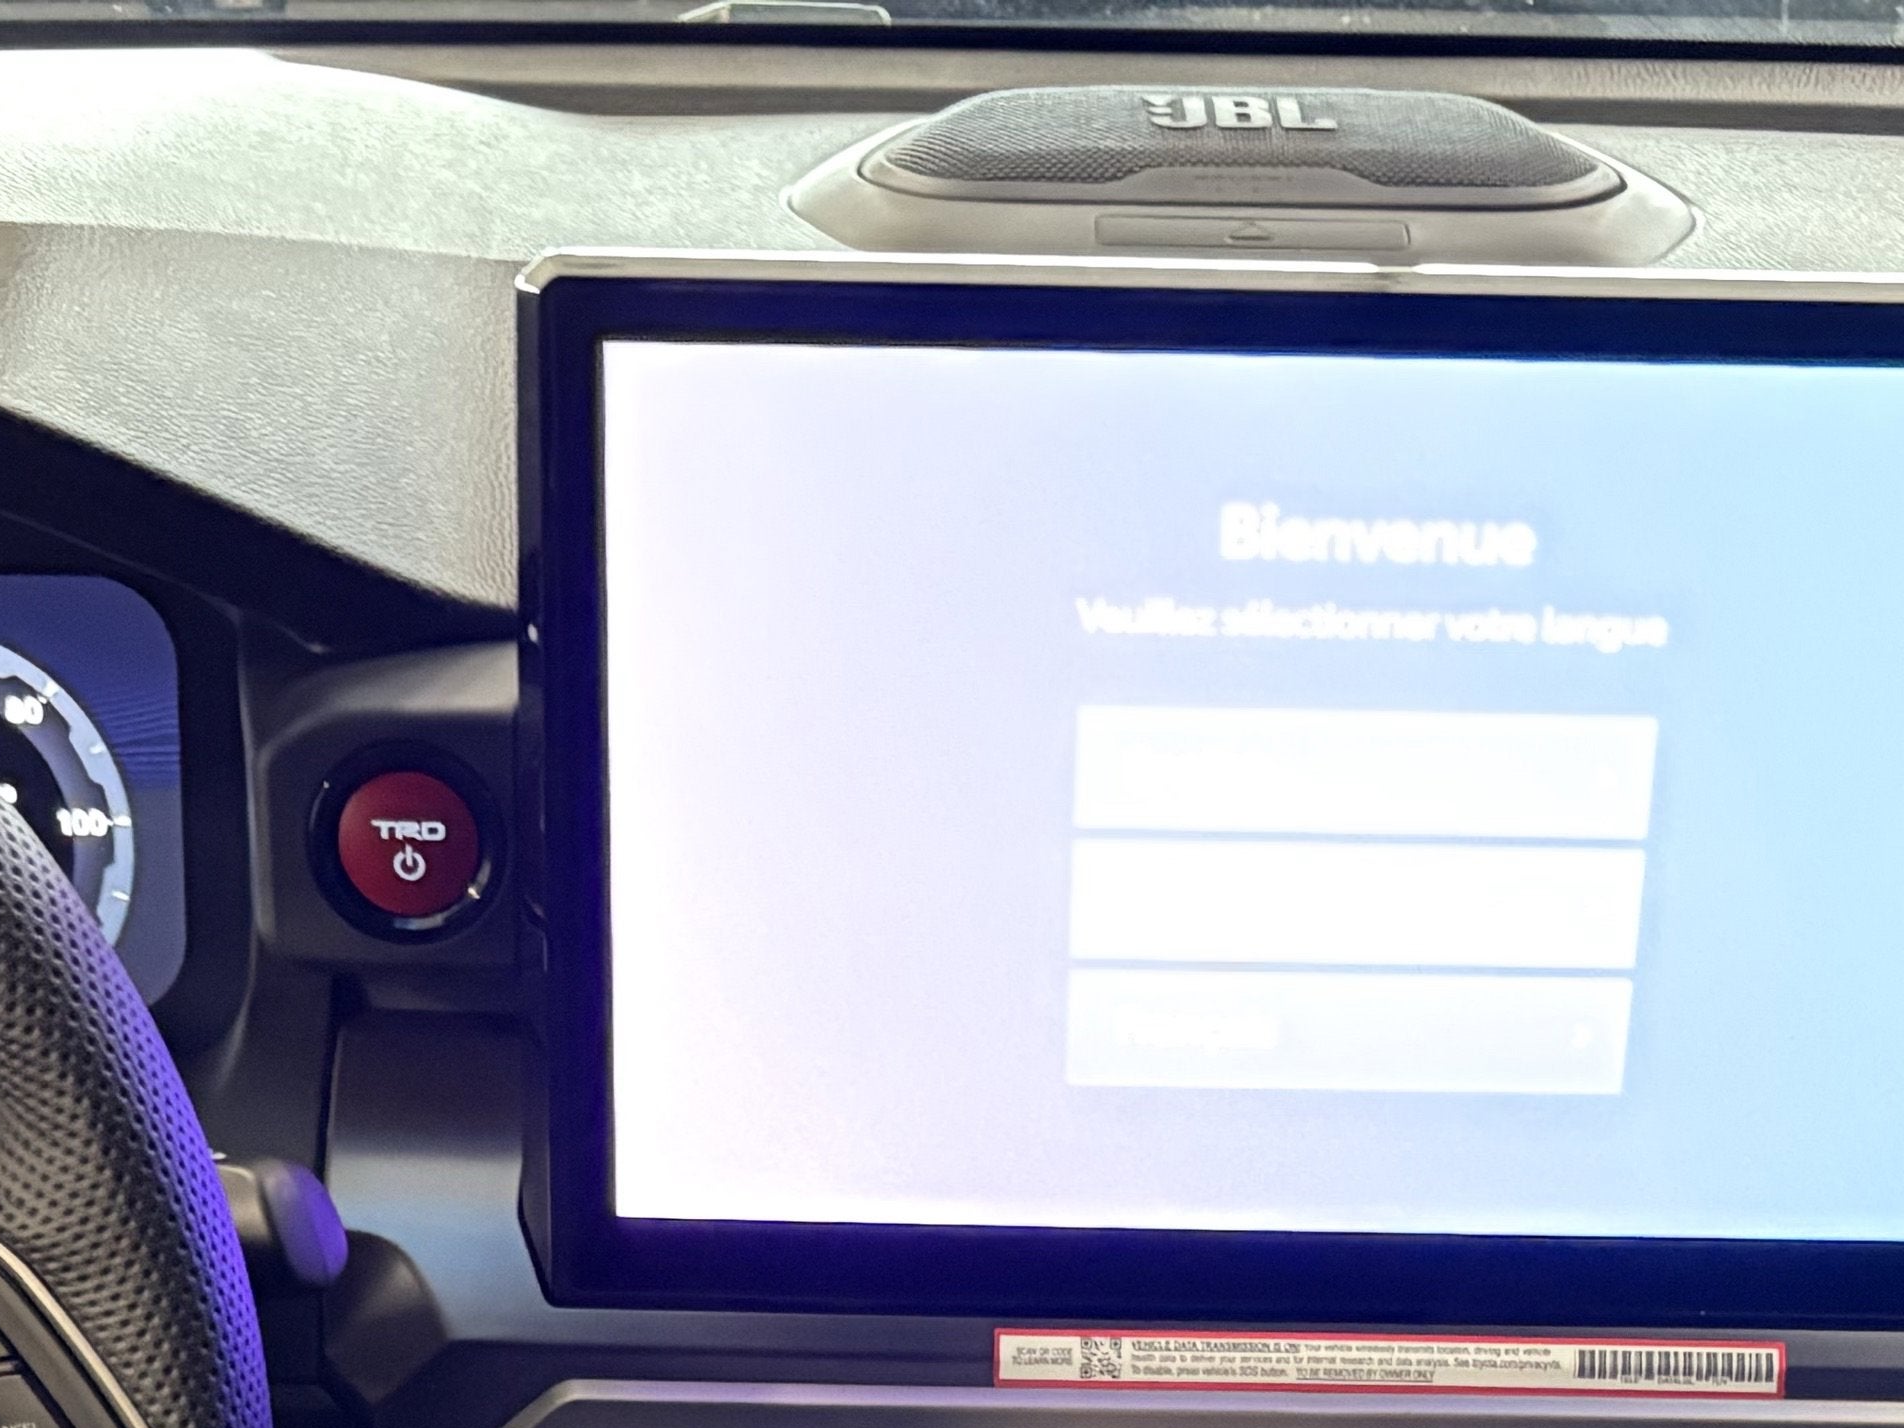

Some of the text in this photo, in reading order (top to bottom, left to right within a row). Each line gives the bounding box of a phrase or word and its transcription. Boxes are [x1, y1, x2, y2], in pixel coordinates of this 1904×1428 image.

[1142, 95, 1338, 130] JBL
[1219, 500, 1537, 566] Bienvenue
[1541, 605, 1669, 653] langue
[56, 808, 108, 837] 100
[370, 819, 446, 841] TRD
